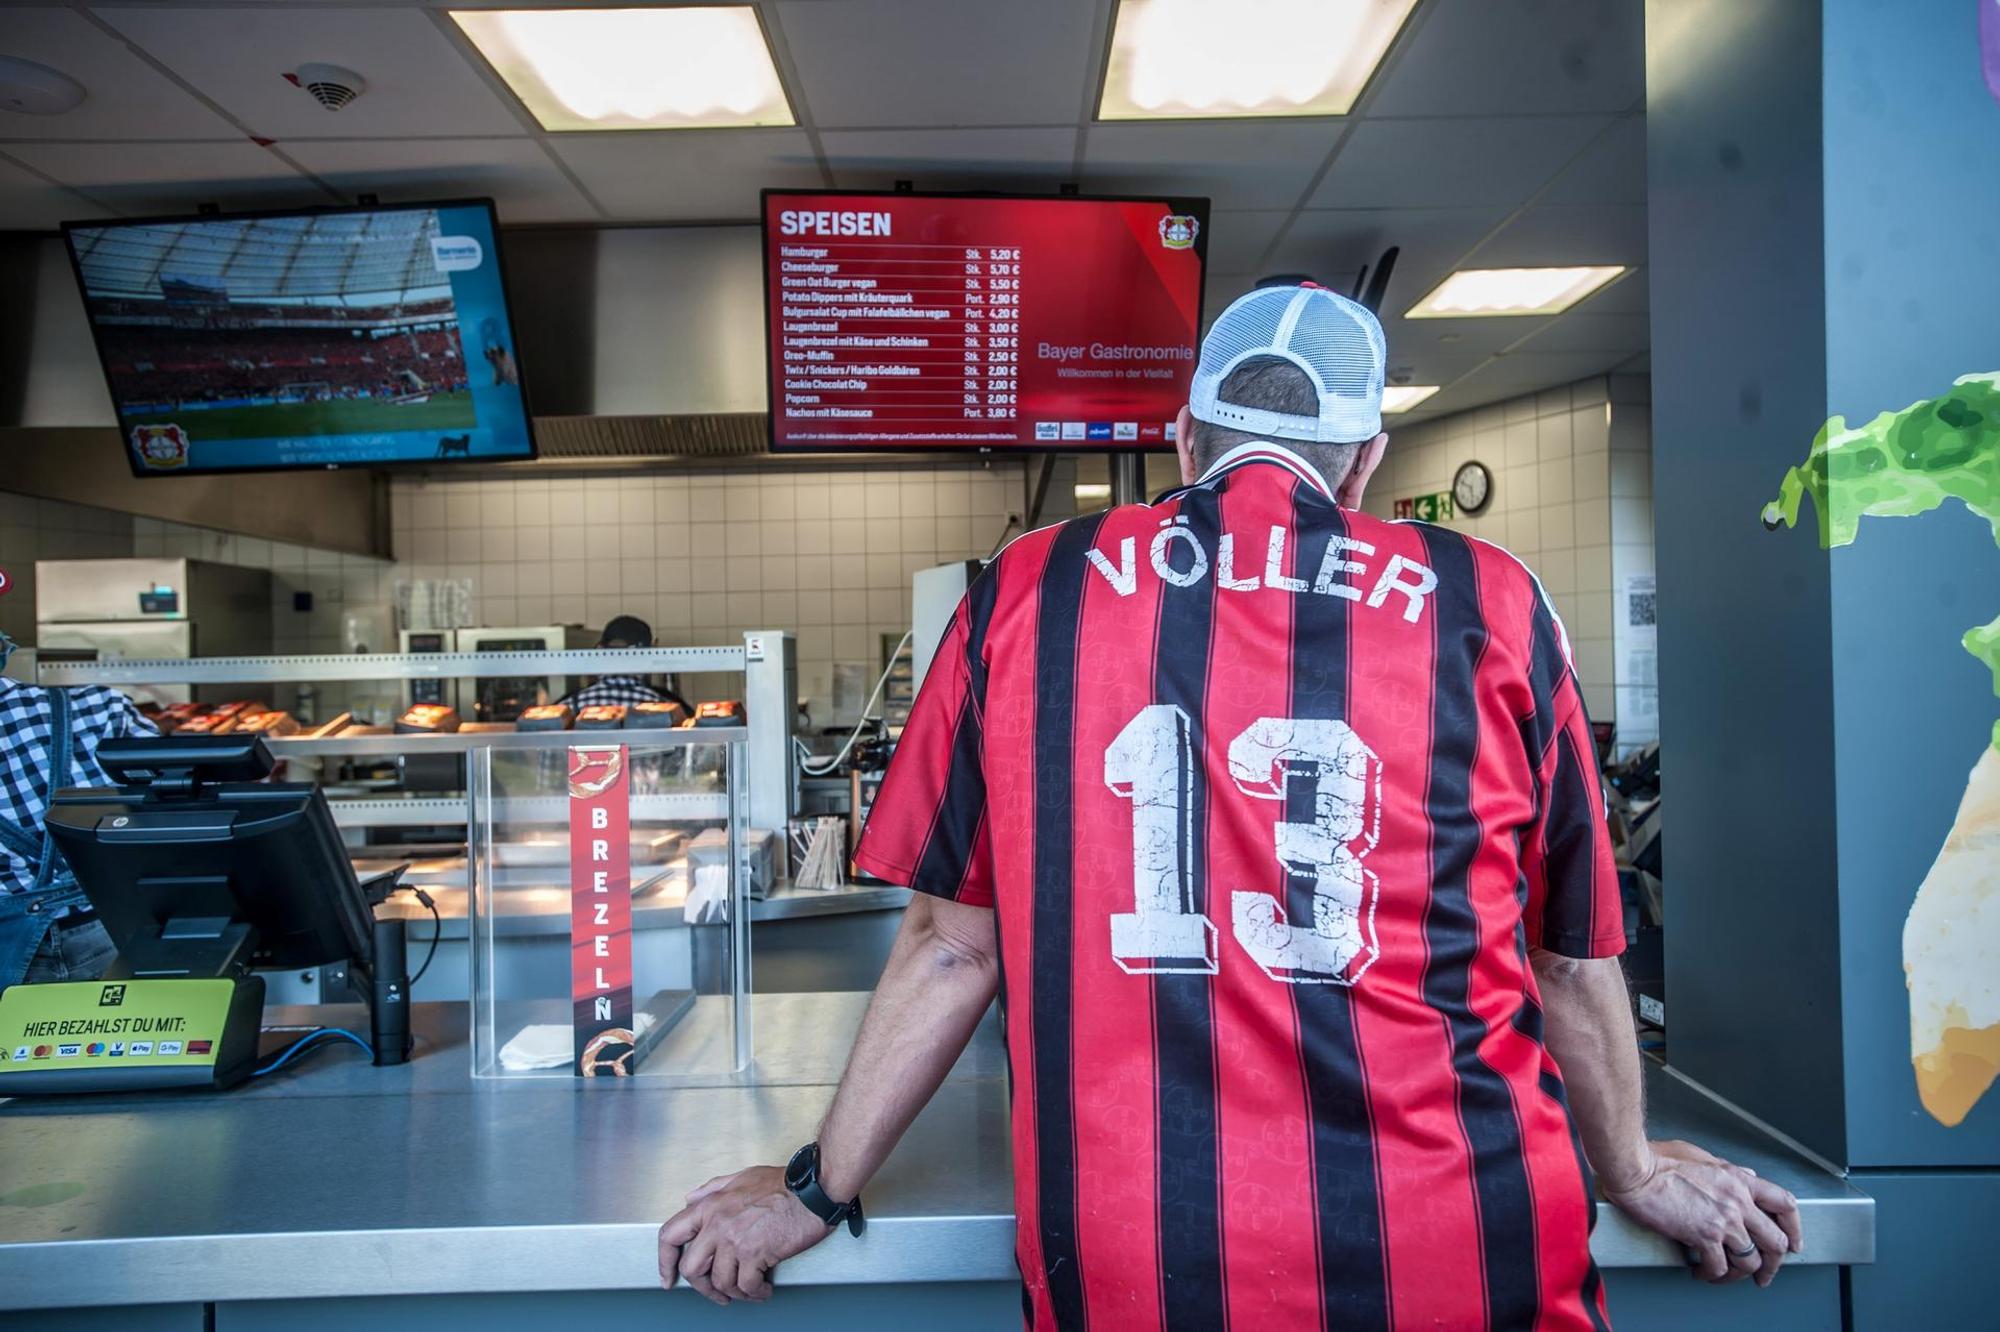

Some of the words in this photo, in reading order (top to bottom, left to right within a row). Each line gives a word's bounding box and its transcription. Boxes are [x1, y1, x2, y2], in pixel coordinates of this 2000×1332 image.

[781, 211, 891, 236] SPEISEN
[781, 247, 828, 258] Hamburger
[966, 249, 981, 260] Stk.
[990, 249, 1010, 260] 5,20
[1013, 249, 1020, 260] €
[782, 262, 839, 273] Cheeseburger
[966, 264, 981, 275] Stk.
[990, 264, 1010, 275] 5,70
[1013, 264, 1020, 275] €
[782, 277, 806, 287] Green
[823, 278, 850, 289] Burger
[851, 280, 876, 289] vegan
[965, 279, 981, 290] Stk.
[990, 279, 1009, 290] 5,50
[1012, 279, 1019, 290] €
[782, 292, 810, 302] Potato
[811, 292, 843, 303] Dippers
[844, 293, 858, 302] mit
[859, 293, 913, 304] Kräuterquark
[965, 293, 984, 304] Port.
[1012, 293, 1019, 304] €
[783, 306, 830, 318] Bulgursalat
[831, 307, 847, 318] Cup
[848, 308, 862, 317] mit
[863, 308, 925, 318] Falafelbällchen
[926, 310, 950, 319] vegan
[965, 308, 984, 318] Port.
[989, 308, 1009, 319] 4,20
[1012, 308, 1019, 318] €
[783, 321, 838, 333] Laugenbrezel
[965, 323, 980, 334] Stk.
[989, 323, 1008, 334] 3,00
[1011, 323, 1018, 334] €
[784, 336, 838, 347] Laugenbrezel
[839, 336, 853, 346] mit
[854, 336, 873, 346] Käse
[874, 337, 890, 346] und
[891, 337, 929, 347] Schinken
[965, 338, 980, 348] Stk.
[989, 338, 1008, 348] 3,50
[1011, 338, 1018, 348] €
[784, 350, 834, 361] Oreo-Muffin
[965, 352, 980, 362] Stk.
[989, 352, 1008, 362] 2,50
[1010, 352, 1017, 362] €
[1038, 343, 1085, 362] Bayer
[1090, 344, 1194, 360] Gastronomie
[785, 365, 804, 375] Twix
[810, 365, 845, 375] Snickers
[851, 365, 878, 375] Haribo
[878, 366, 920, 376] Goldbären
[965, 366, 979, 376] Stk.
[989, 366, 1007, 377] 2,00
[1010, 366, 1017, 376] €
[1057, 368, 1113, 378] Willkommen
[1115, 368, 1123, 378] in
[1126, 369, 1141, 378] der
[1144, 369, 1173, 379] Vielfalt
[785, 379, 812, 389] Cookie
[812, 380, 848, 389] Chocolat
[849, 380, 867, 391] Chip
[965, 380, 979, 390] Stk.
[988, 380, 1007, 391] 2,00
[1010, 380, 1017, 390] €
[785, 394, 820, 405] Popcorn
[964, 394, 979, 405] Stk.
[988, 394, 1007, 405] 2,00
[1009, 394, 1016, 405] €
[786, 408, 815, 417] Nachos
[816, 408, 830, 417] mit
[831, 408, 873, 418] Käsesauce
[964, 408, 982, 419] Port.
[1009, 408, 1016, 419] €
[1085, 516, 1438, 624] VÖLLER
[1104, 704, 1382, 985] 13
[591, 808, 611, 1021] BREZELN
[24, 1022, 55, 1037] HIER
[58, 1018, 130, 1035] BEZAHLST
[133, 1018, 153, 1033] DU
[155, 1017, 186, 1032] MIT:
[59, 1047, 78, 1055] VISA
[137, 1045, 150, 1053] Pay
